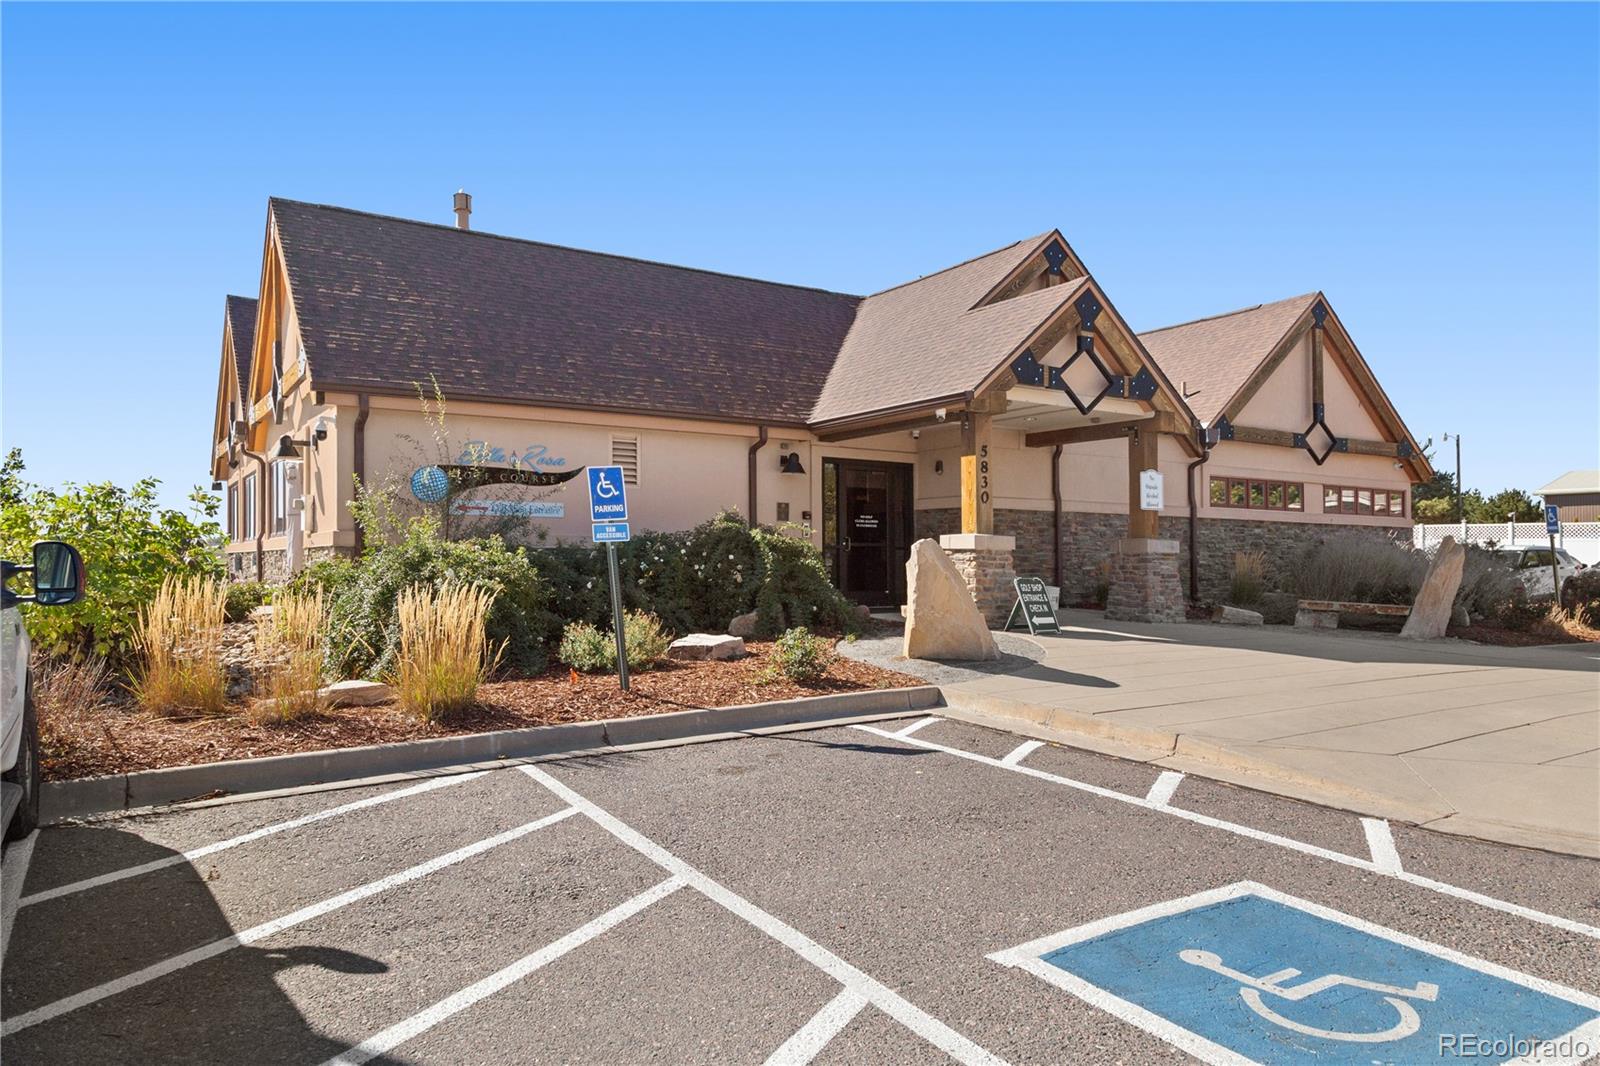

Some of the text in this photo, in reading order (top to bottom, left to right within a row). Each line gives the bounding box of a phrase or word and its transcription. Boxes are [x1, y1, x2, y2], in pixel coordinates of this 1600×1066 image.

[521, 445, 566, 474] Rosa
[500, 473, 555, 484] COURSE
[980, 444, 989, 504] 5830
[594, 504, 624, 512] PARKING
[1020, 583, 1043, 592] GOLF SHOP
